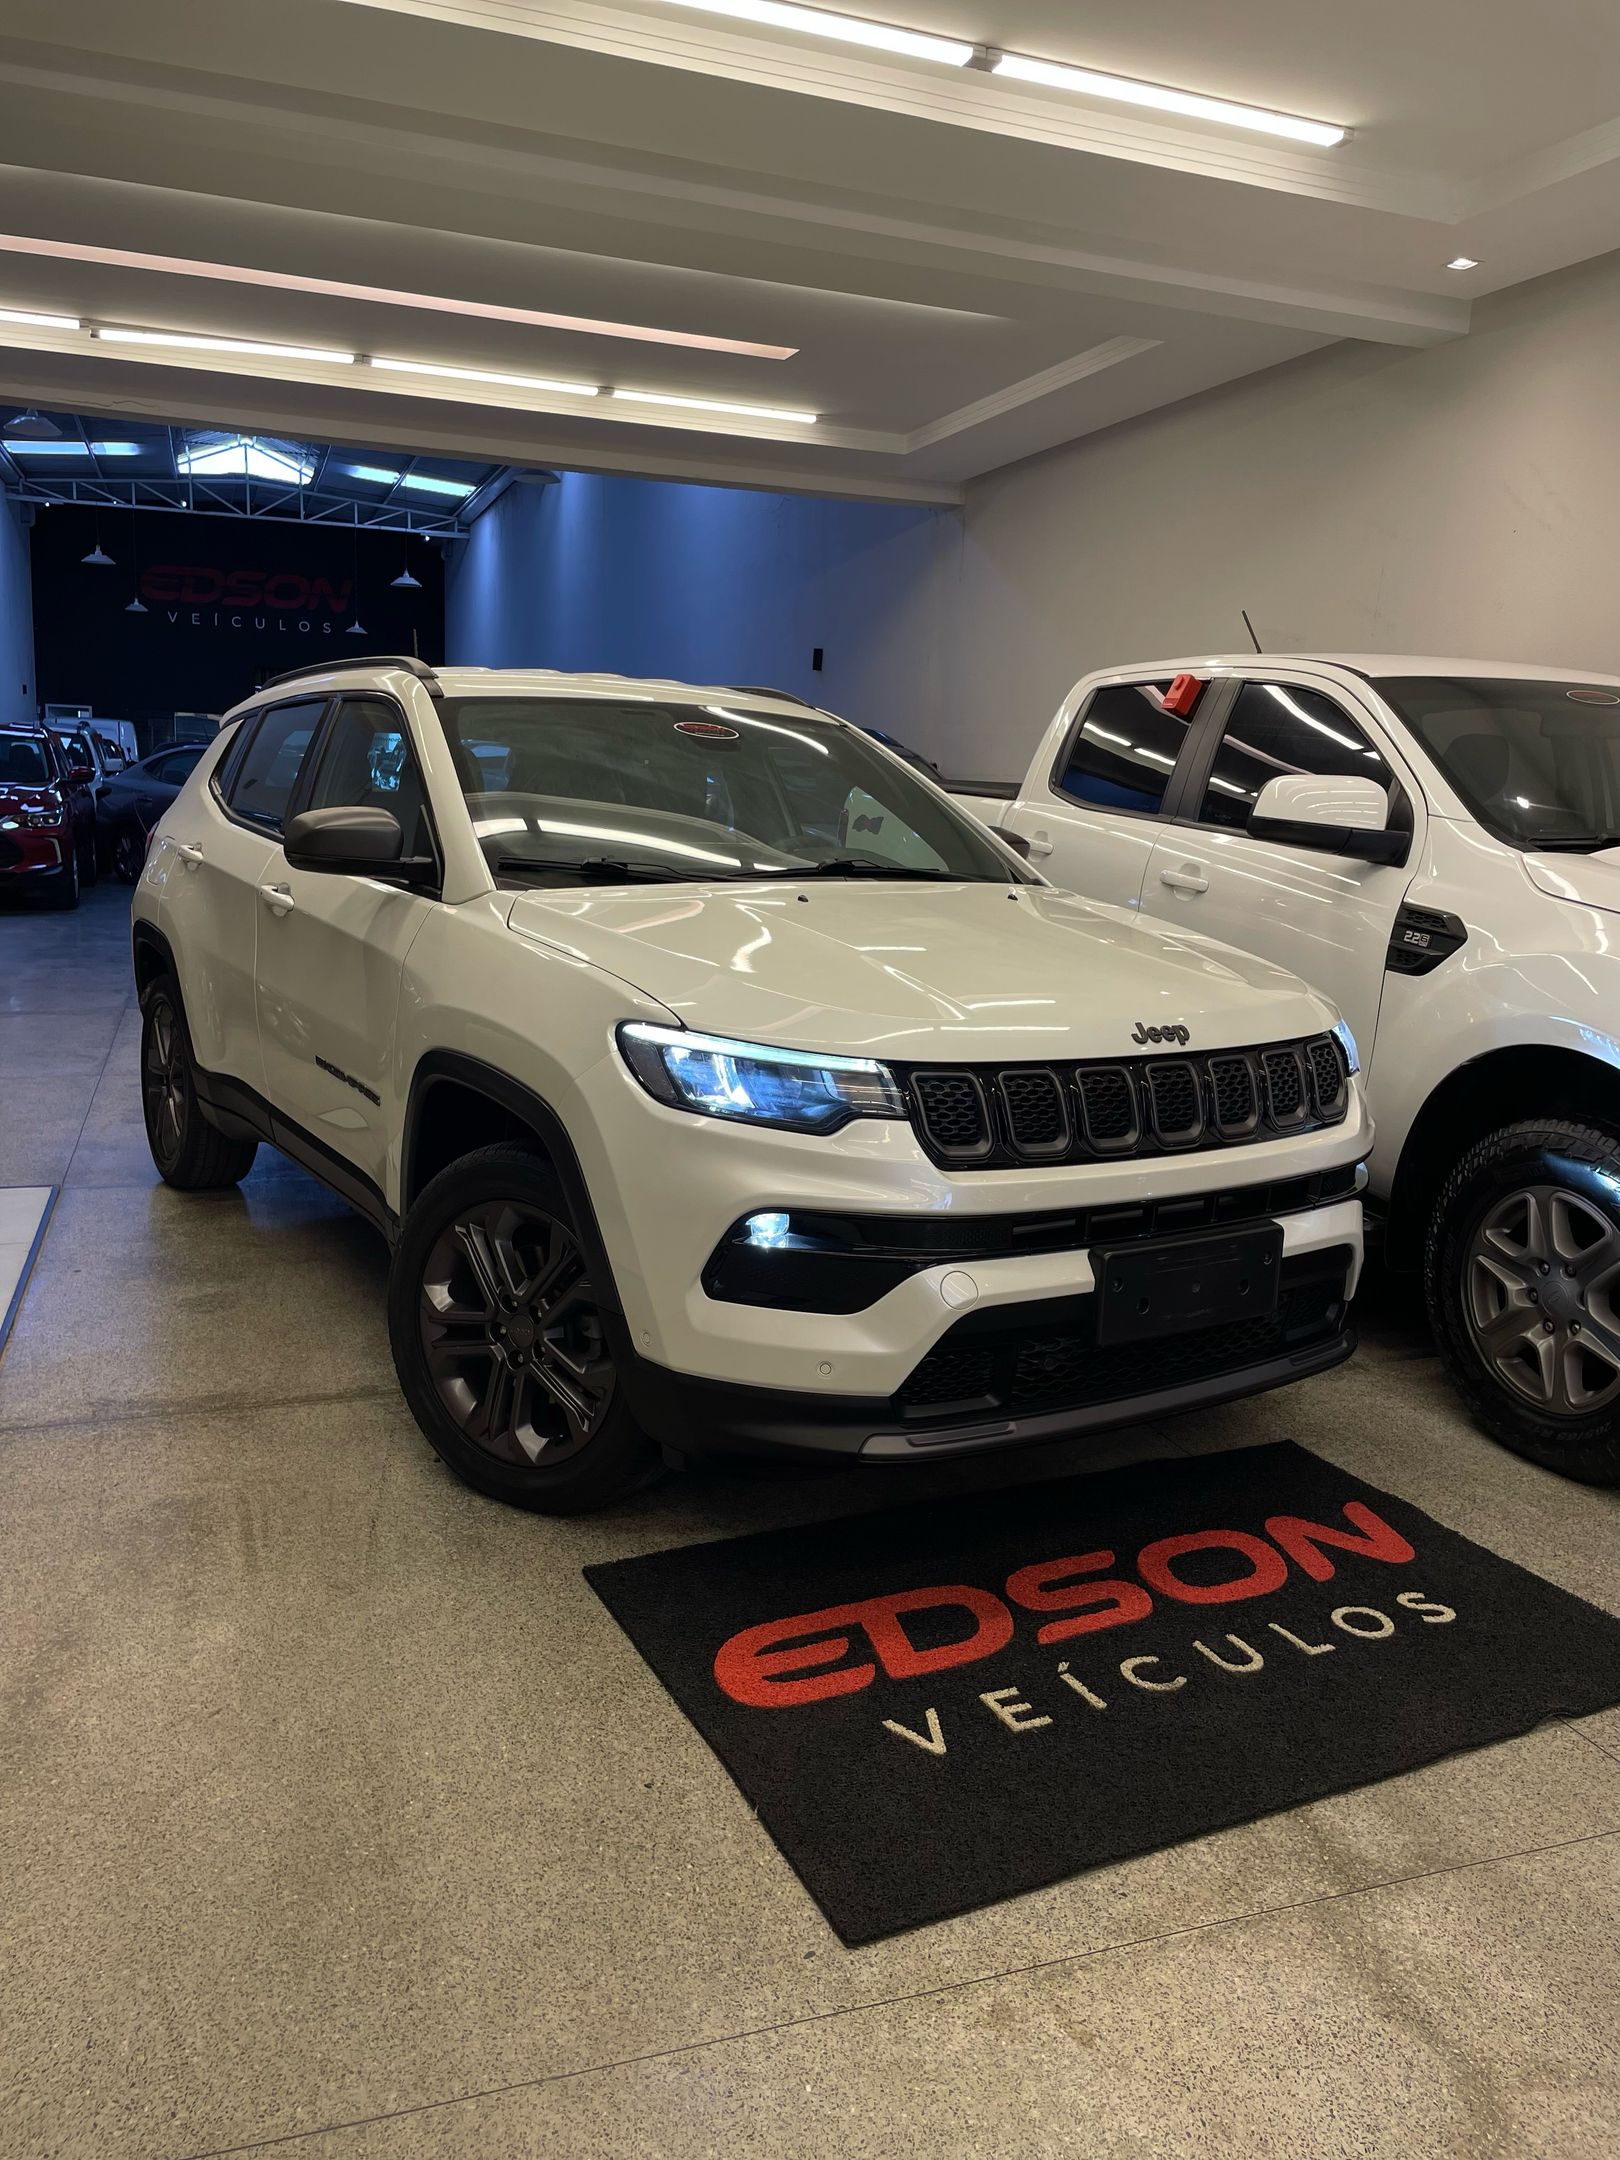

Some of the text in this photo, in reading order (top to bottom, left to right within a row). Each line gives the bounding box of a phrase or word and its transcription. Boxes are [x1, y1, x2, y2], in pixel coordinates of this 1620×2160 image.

[141, 566, 352, 612] EDSON
[168, 611, 331, 634] VEÍCULOS
[1131, 1022, 1190, 1046] Jeep
[713, 1501, 1415, 1708] EDSON
[882, 1591, 1457, 1756] VEÍCULOS
